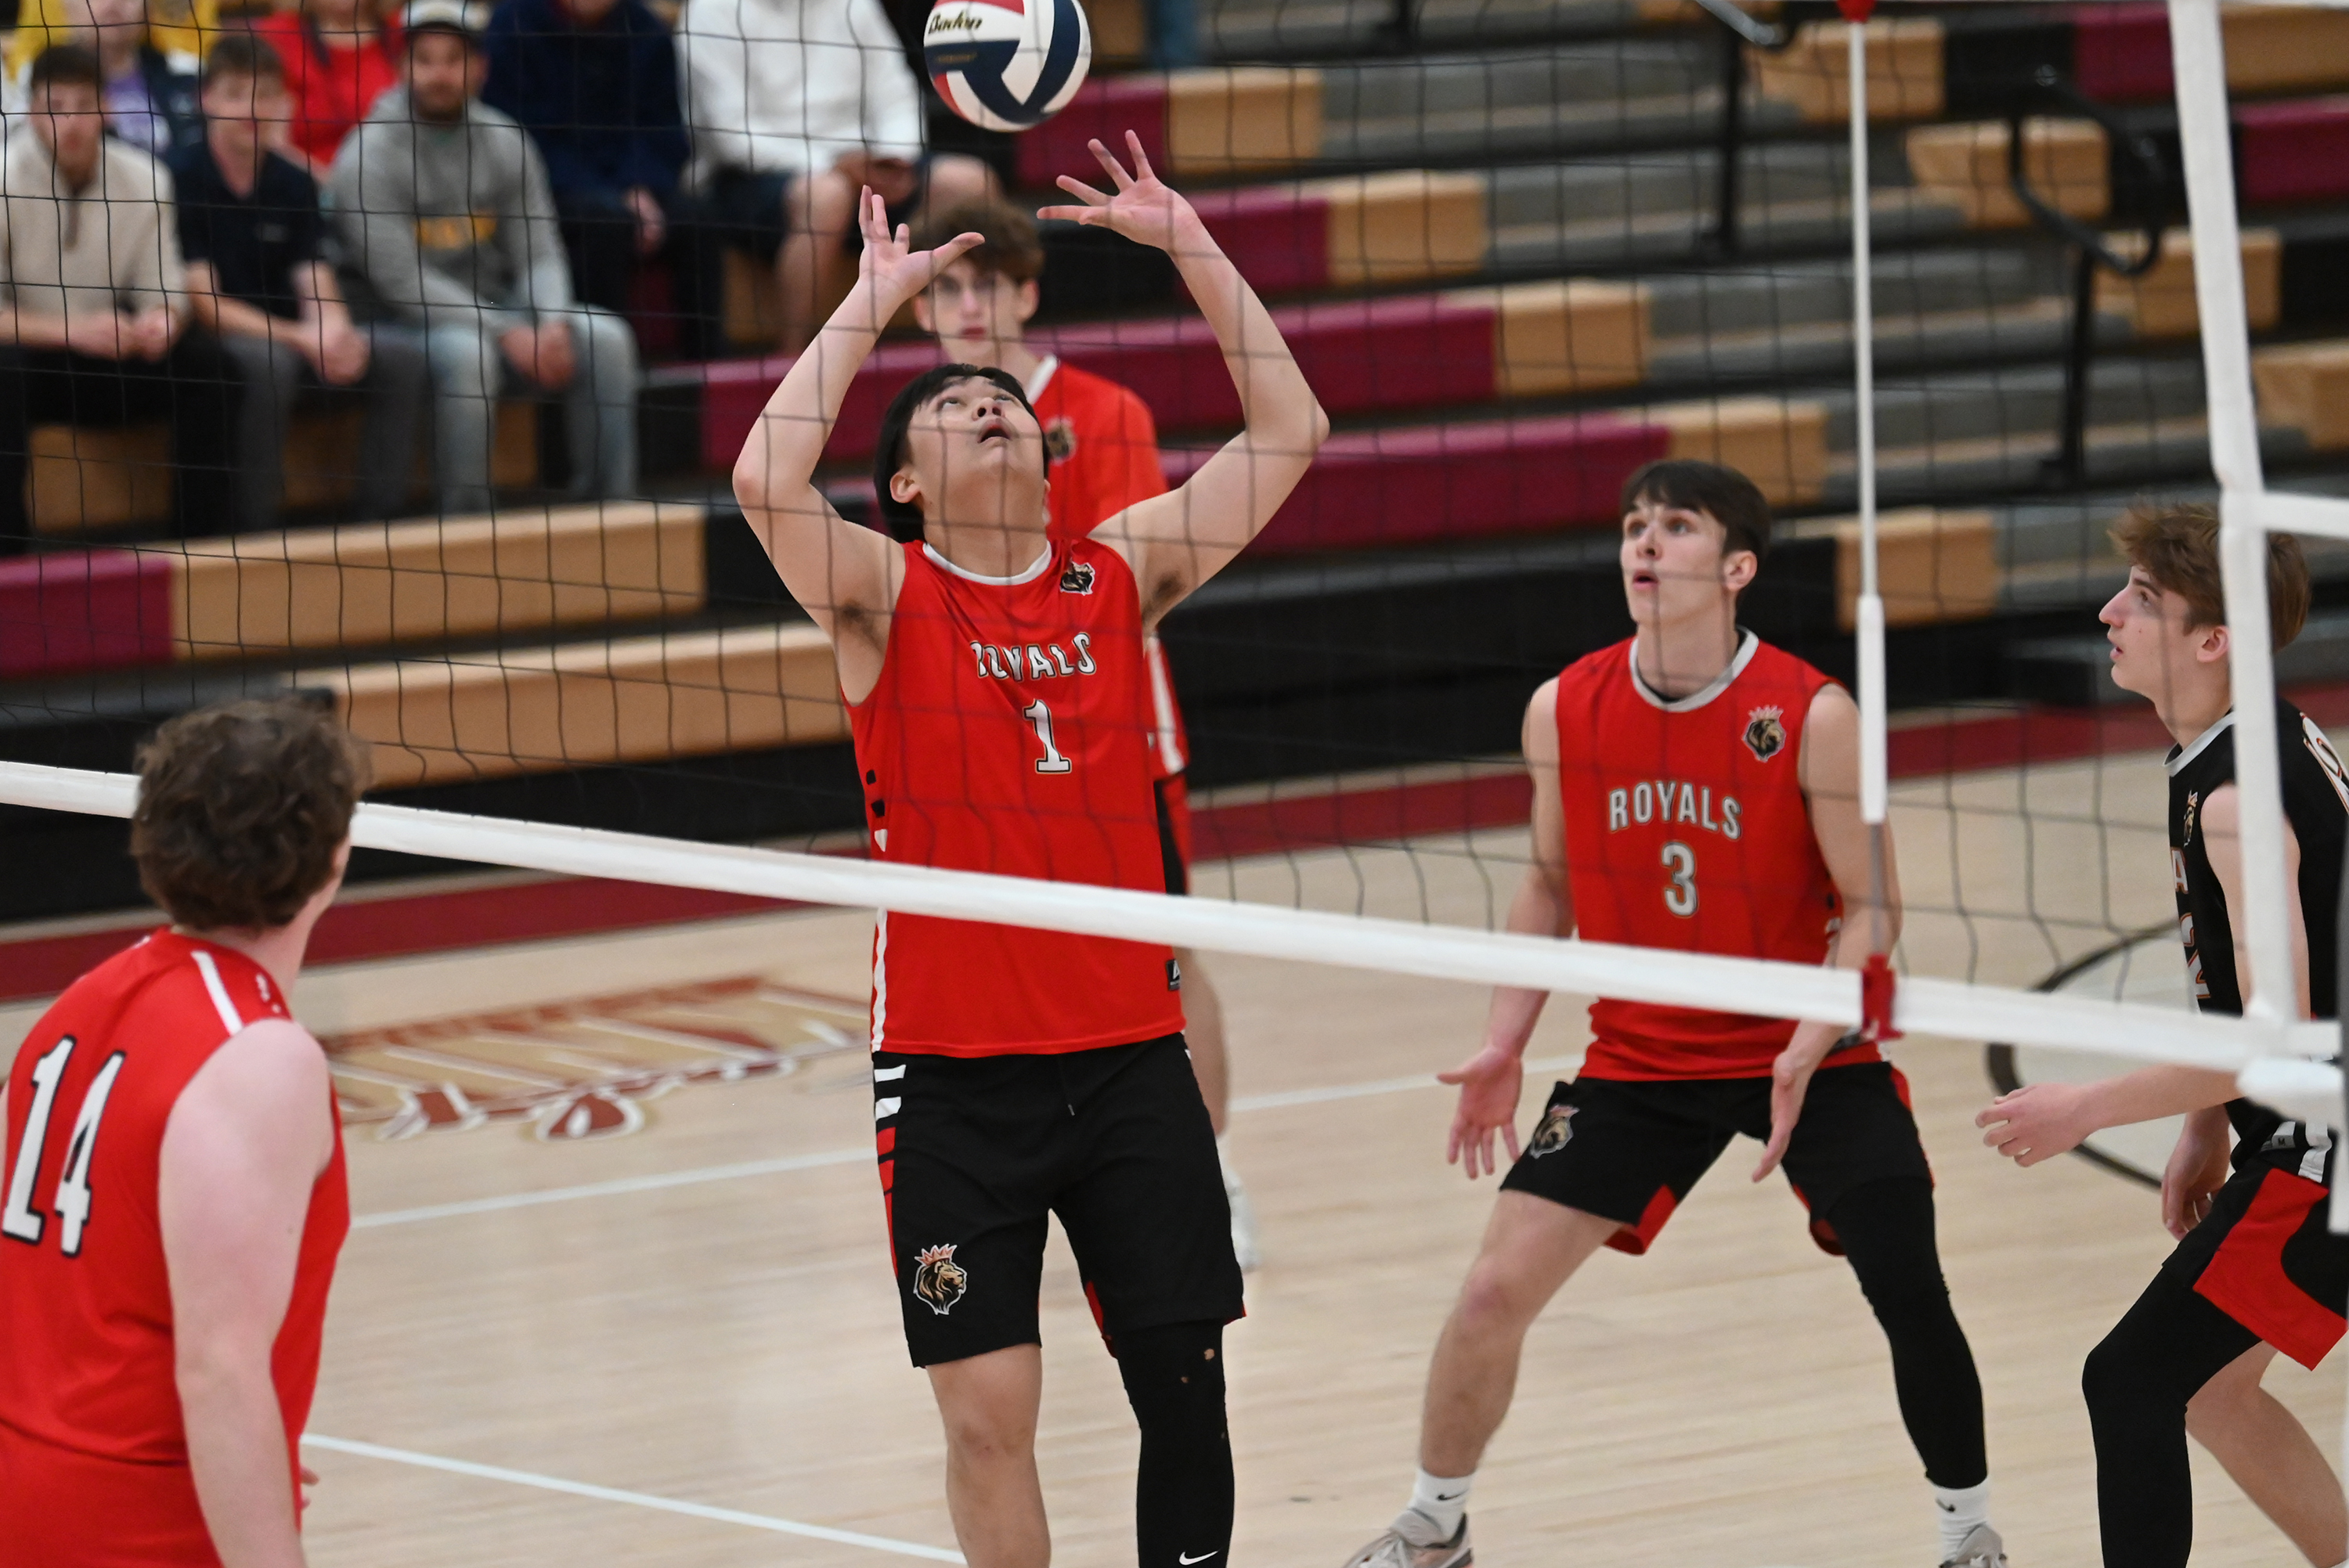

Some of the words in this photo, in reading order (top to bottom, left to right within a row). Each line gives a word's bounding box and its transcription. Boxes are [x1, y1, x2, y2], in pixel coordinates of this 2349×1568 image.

[969, 632, 1096, 682] ROYALS
[1023, 698, 1072, 773] 1
[1608, 780, 1742, 842] ROYALS
[1661, 840, 1698, 918] 3
[2, 1034, 126, 1257] 14
